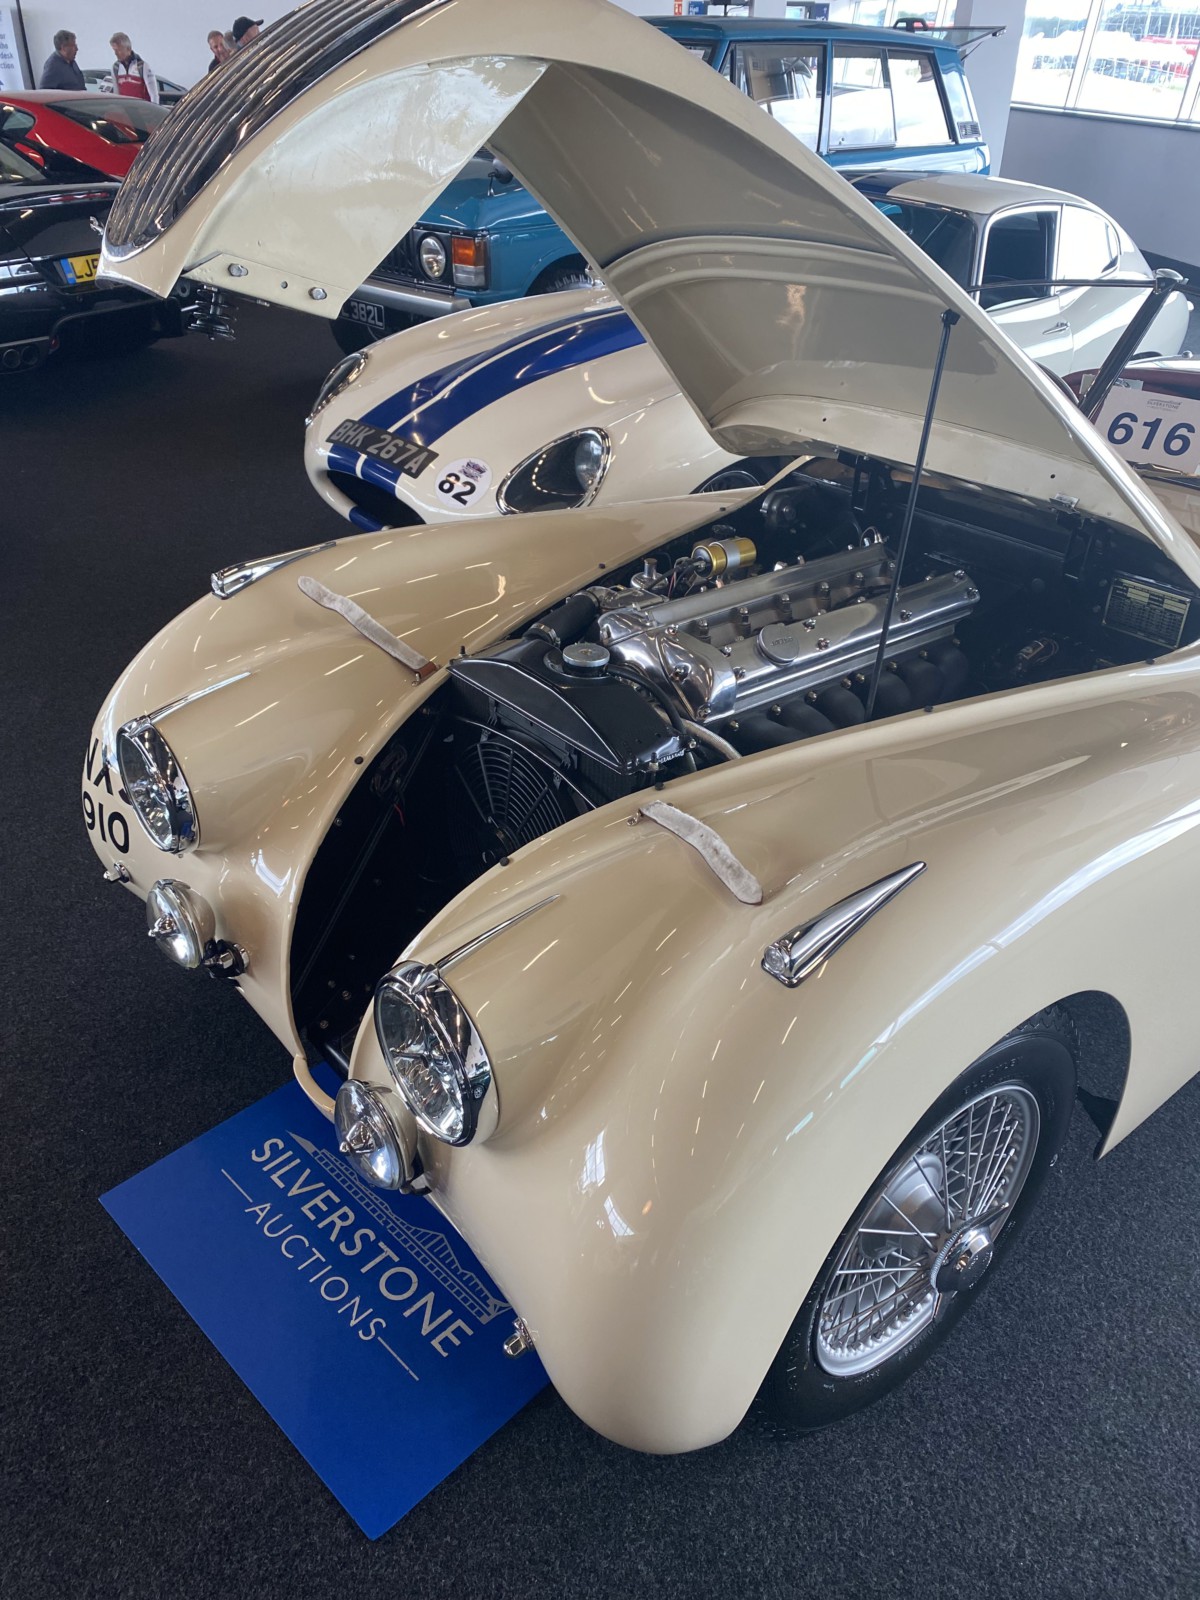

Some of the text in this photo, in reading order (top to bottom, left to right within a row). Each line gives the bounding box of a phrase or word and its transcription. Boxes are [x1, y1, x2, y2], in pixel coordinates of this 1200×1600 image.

[350, 301, 384, 327] 382L
[366, 433, 429, 474] 267A
[1107, 411, 1196, 457] 616
[438, 472, 477, 506] 82
[251, 1137, 474, 1358] SILVERSTONE
[244, 1202, 387, 1341] AUCTIONS
